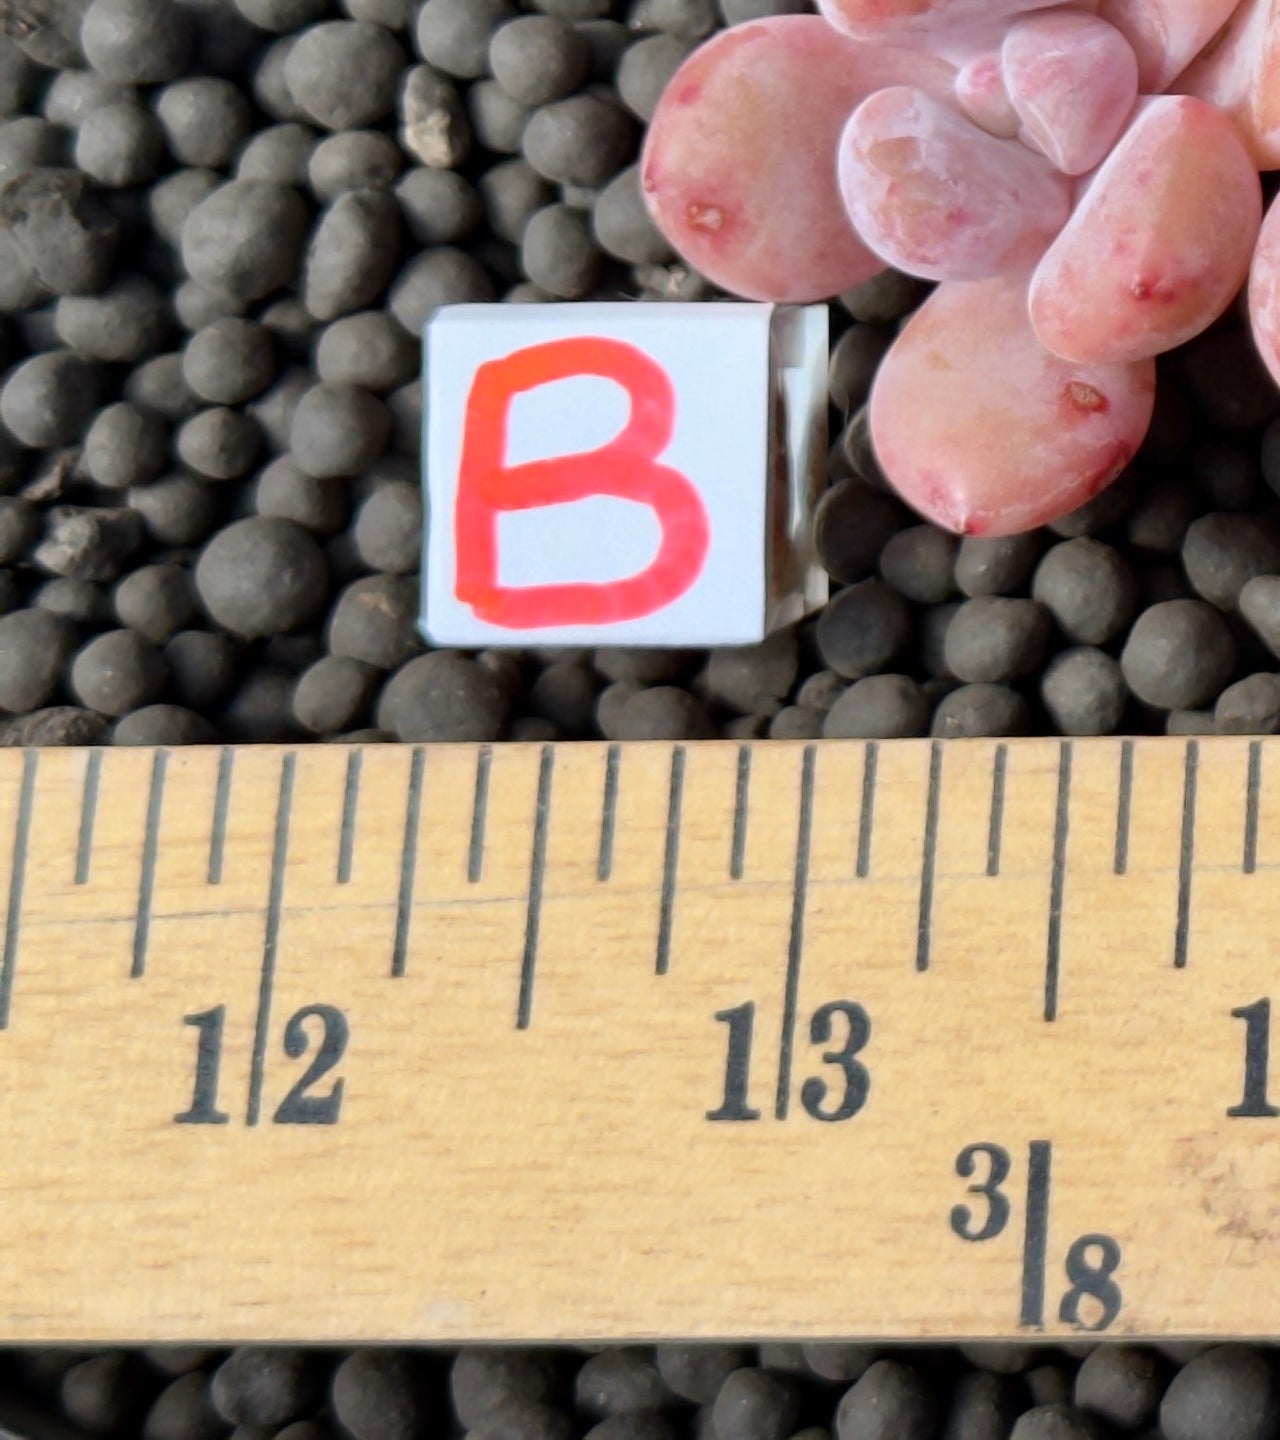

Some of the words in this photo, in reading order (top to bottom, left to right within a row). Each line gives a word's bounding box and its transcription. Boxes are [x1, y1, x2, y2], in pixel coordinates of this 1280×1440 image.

[453, 335, 711, 631] B
[175, 1006, 346, 1125] 12
[706, 1002, 870, 1122] 13
